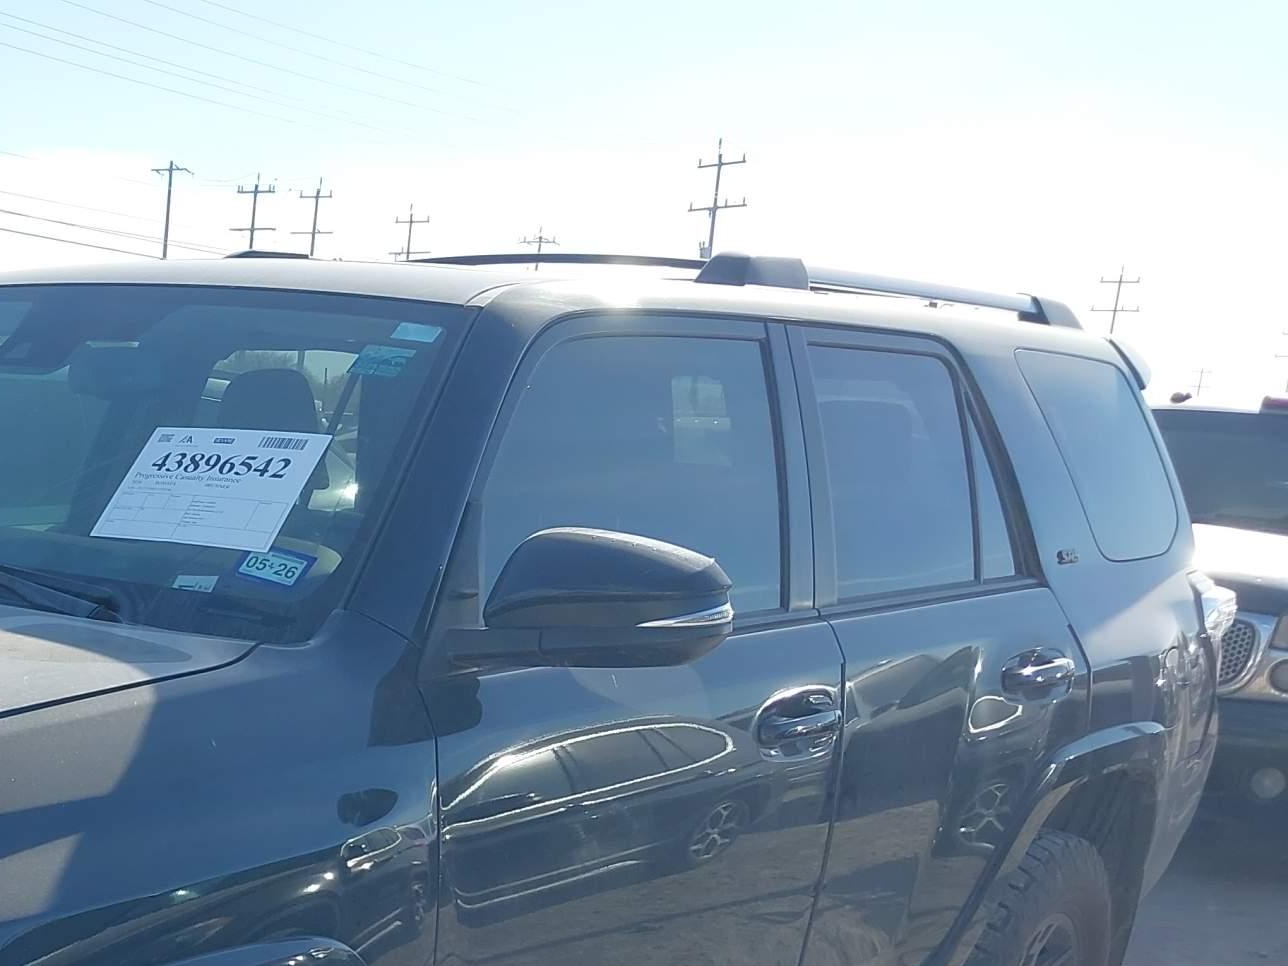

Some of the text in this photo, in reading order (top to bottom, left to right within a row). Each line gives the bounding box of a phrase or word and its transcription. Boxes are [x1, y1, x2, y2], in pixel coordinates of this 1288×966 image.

[151, 451, 292, 478] 43896542
[134, 471, 242, 485] Progressive Casualty Insurance
